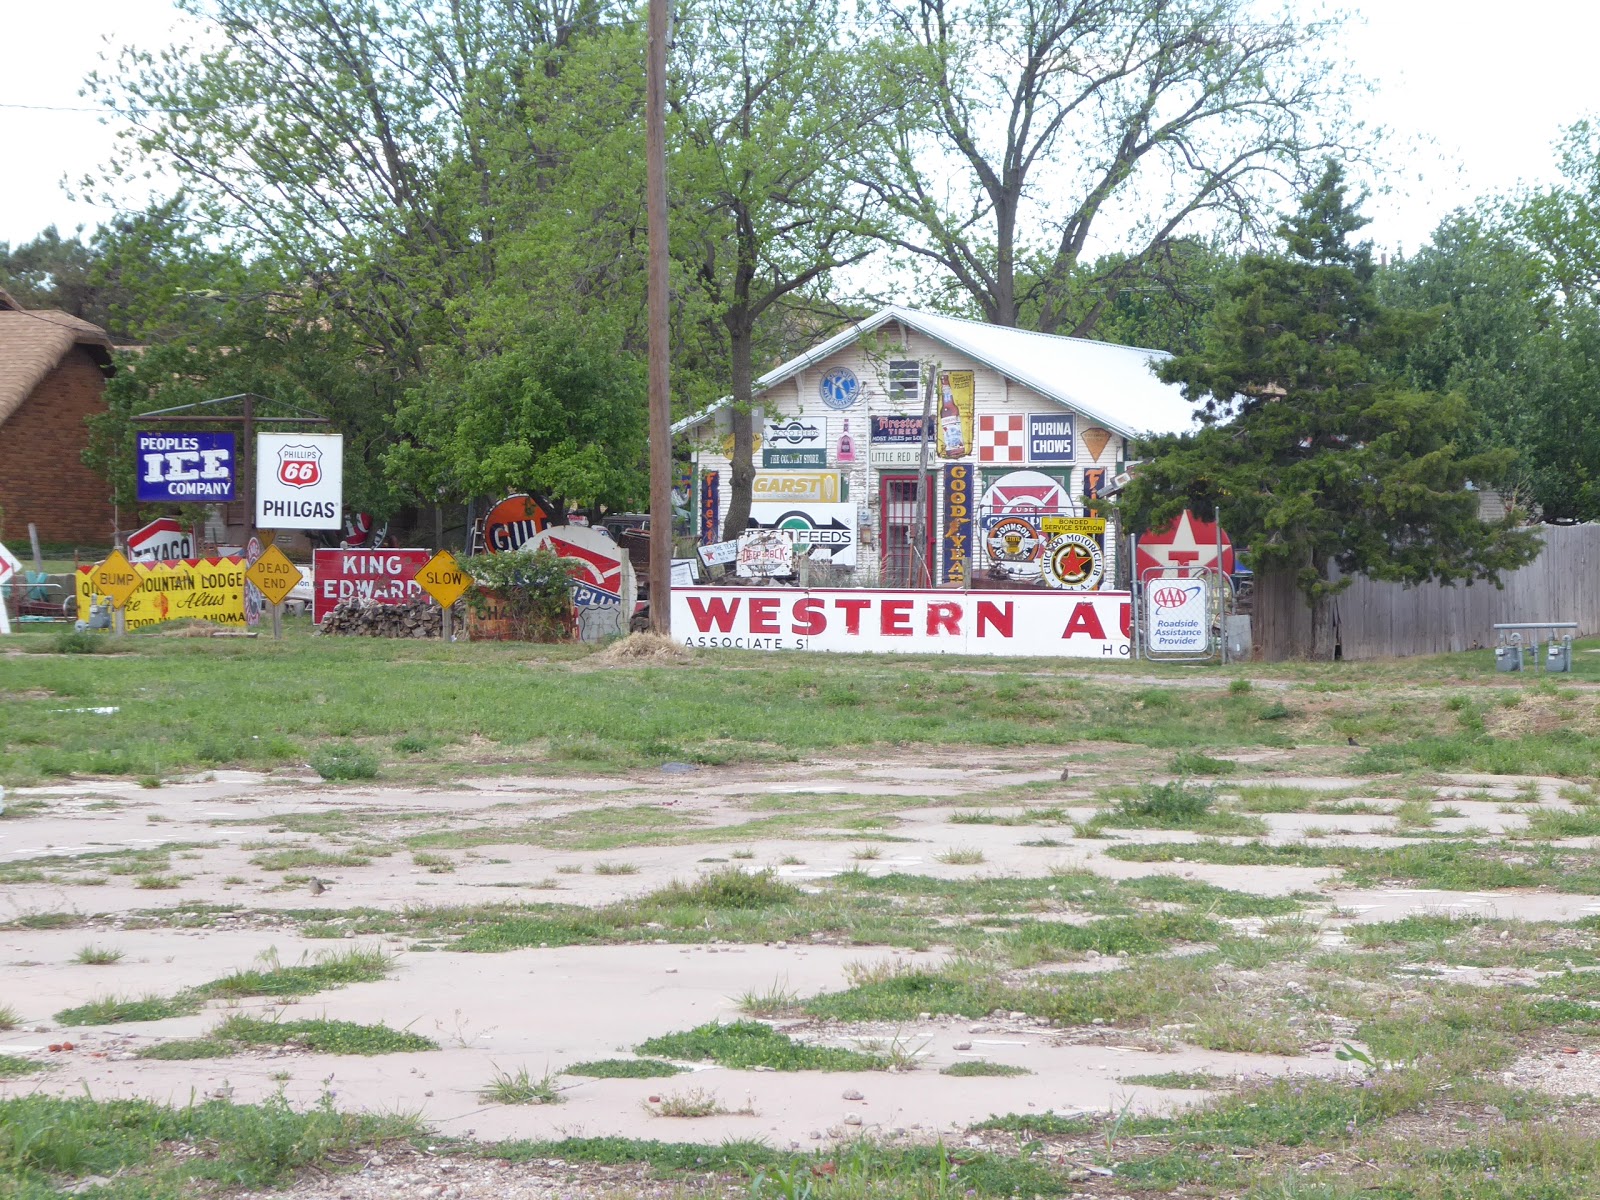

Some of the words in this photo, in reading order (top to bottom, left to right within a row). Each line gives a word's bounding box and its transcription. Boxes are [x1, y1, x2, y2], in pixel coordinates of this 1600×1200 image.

[1032, 422, 1072, 436] PURINA
[140, 437, 199, 450] PEOPLES
[1033, 439, 1071, 453] CHOWS
[284, 451, 317, 459] PHILLIPS
[770, 455, 780, 464] THE
[871, 452, 894, 462] LITTLE
[898, 452, 911, 462] RED
[915, 452, 934, 462] BN
[143, 449, 229, 483] ICE
[284, 462, 313, 480] 66
[168, 482, 231, 495] COMPANY
[753, 477, 821, 493] GARST
[263, 500, 335, 519] PHILGAS
[705, 471, 718, 546] Firest
[947, 465, 968, 583] GOODYEAR
[996, 523, 1031, 538] JOHNSON
[799, 531, 852, 543] FEEDS
[1043, 537, 1064, 575] CHICGO
[1066, 534, 1098, 553] MOTOR
[1092, 552, 1102, 577] CLUB
[258, 563, 290, 573] DEAD
[343, 556, 402, 574] KING
[100, 573, 135, 585] BUMP
[137, 574, 195, 593] MOUNTAIN
[202, 572, 243, 589] LODGE
[263, 578, 287, 588] END
[426, 572, 462, 585] SLOW
[177, 592, 225, 608] Altus
[1156, 588, 1186, 607] AAA
[126, 618, 155, 629] FOOD
[686, 596, 1014, 638] WESTERN
[1157, 620, 1199, 628] Roadside
[684, 636, 783, 650] ASSOCIATE
[1159, 637, 1198, 645] Provider
